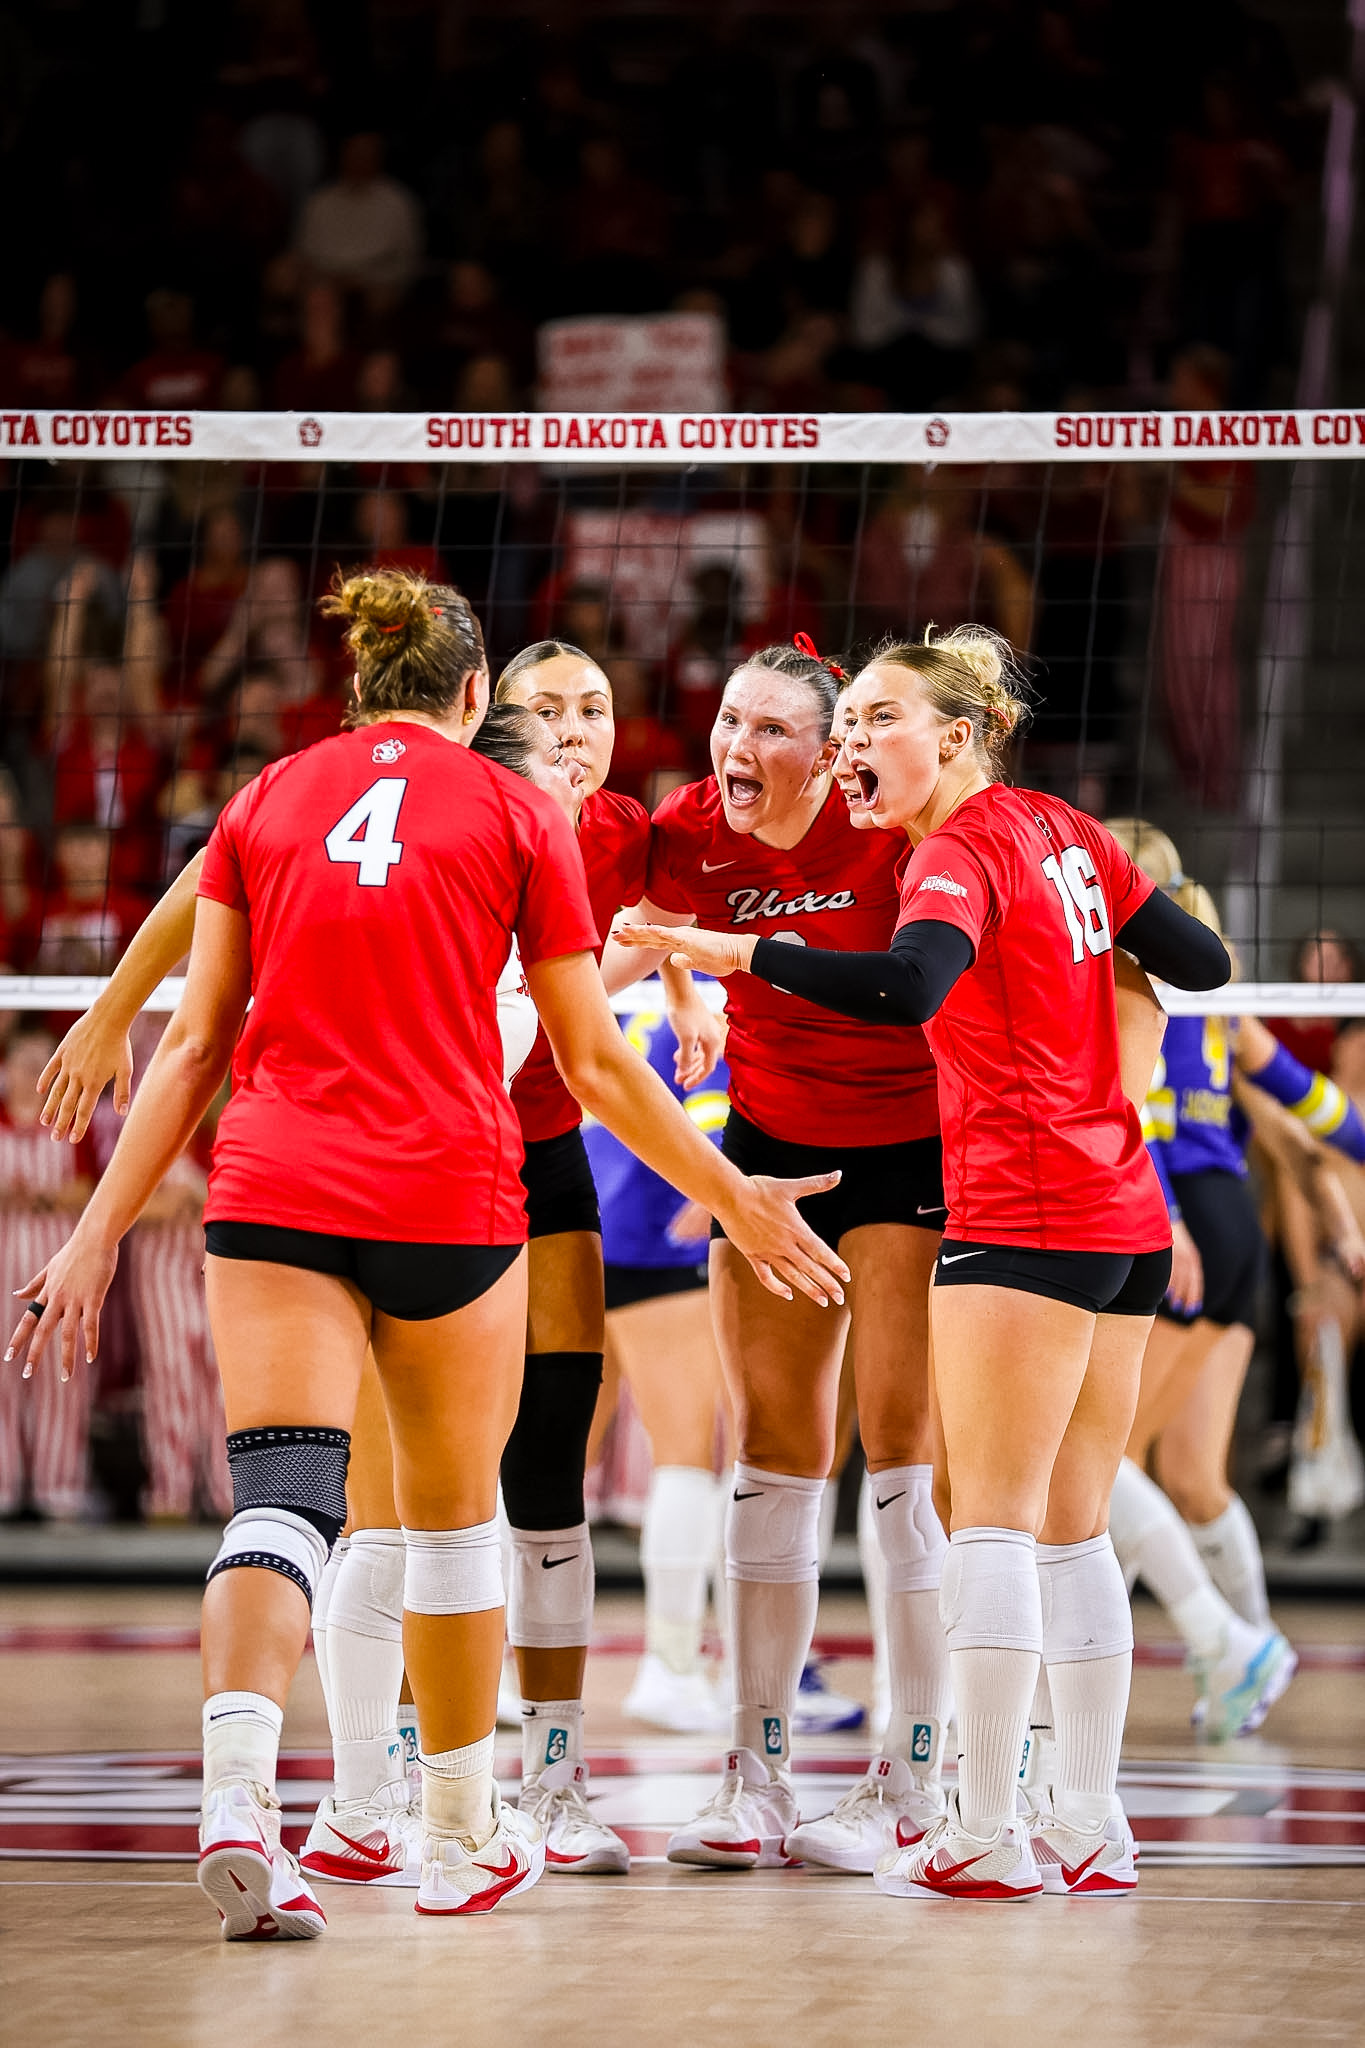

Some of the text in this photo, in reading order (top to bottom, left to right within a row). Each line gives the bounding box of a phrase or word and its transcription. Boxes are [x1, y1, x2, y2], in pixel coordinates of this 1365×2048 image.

[52, 415, 192, 446] COYOTES
[426, 417, 819, 449] SOUTH DAKOTA COYOTES
[1055, 416, 1161, 448] SOUTH
[1173, 415, 1301, 447] DAKOTA
[323, 776, 409, 888] 4
[918, 877, 968, 899] SUMMIT
[1040, 843, 1112, 965] 16
